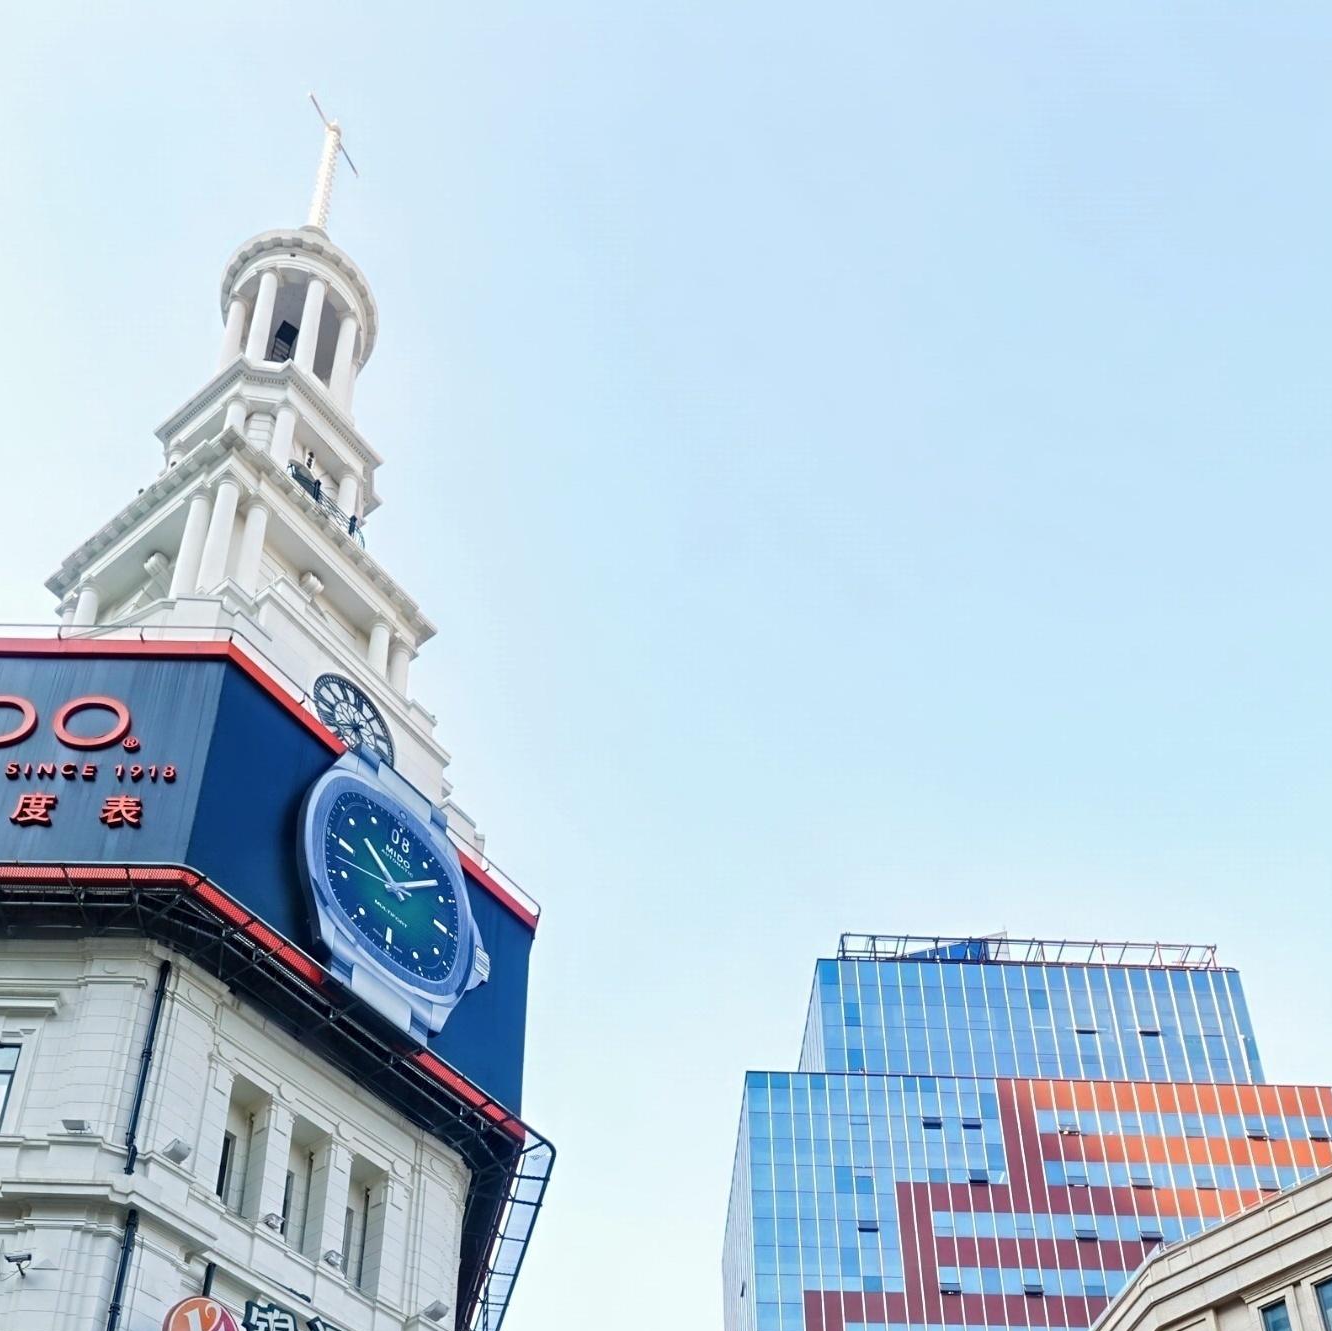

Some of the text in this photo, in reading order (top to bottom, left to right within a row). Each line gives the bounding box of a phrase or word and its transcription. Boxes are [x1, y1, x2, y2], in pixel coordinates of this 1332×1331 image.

[6, 761, 98, 781] SINCE
[115, 763, 178, 783] 1918
[392, 828, 410, 853] 08
[385, 844, 411, 869] MIDO
[374, 899, 408, 929] MULTIFORT
